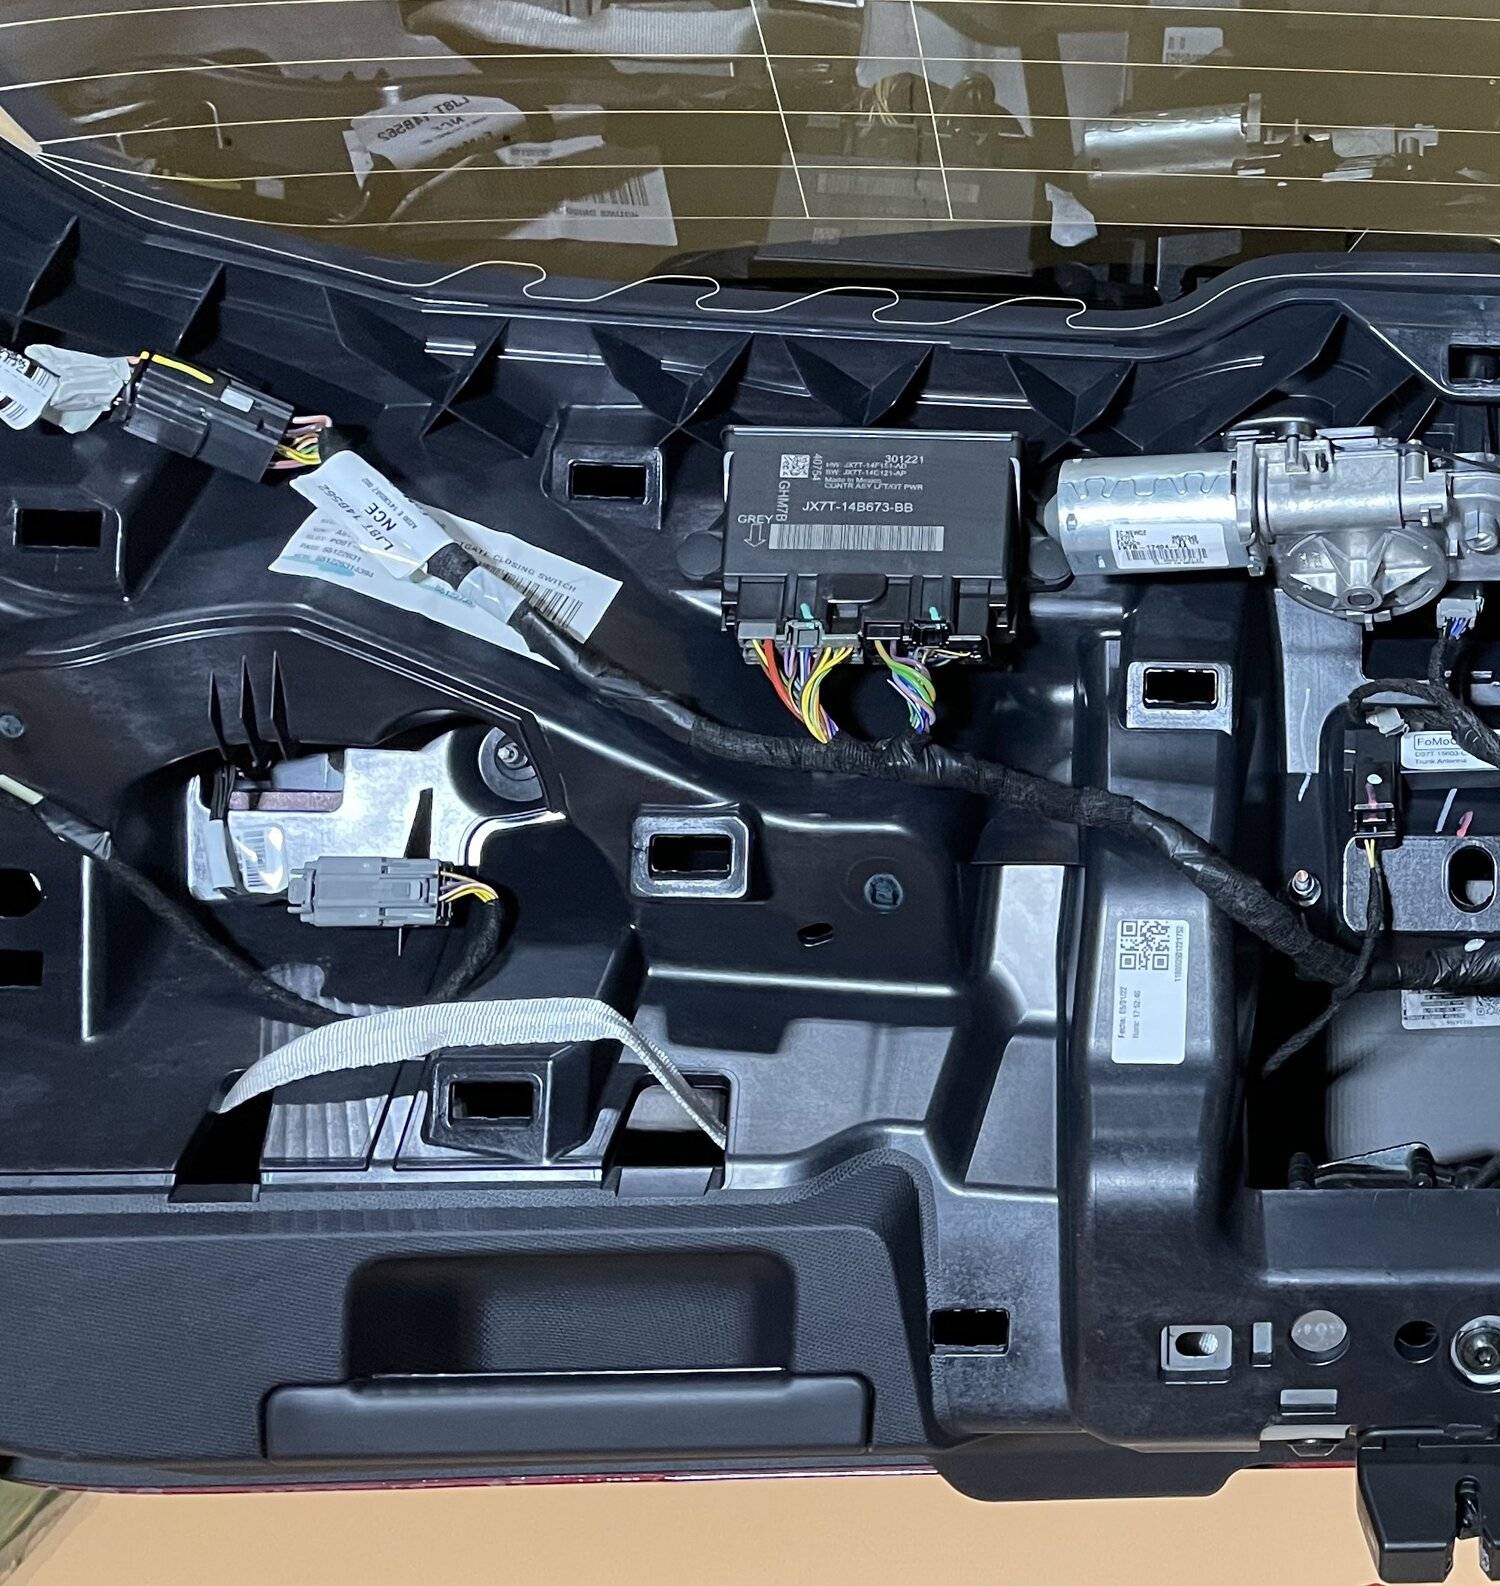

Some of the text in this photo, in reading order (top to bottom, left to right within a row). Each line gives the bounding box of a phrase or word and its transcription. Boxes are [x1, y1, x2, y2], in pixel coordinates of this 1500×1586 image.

[884, 454, 924, 464] 301221
[776, 480, 791, 522] GHM7B
[802, 501, 914, 514] JX7T-14B673-BB
[365, 502, 397, 531] NCE
[737, 514, 773, 524] GREY
[493, 554, 535, 576] CLOSING
[538, 573, 576, 593] SWITCH
